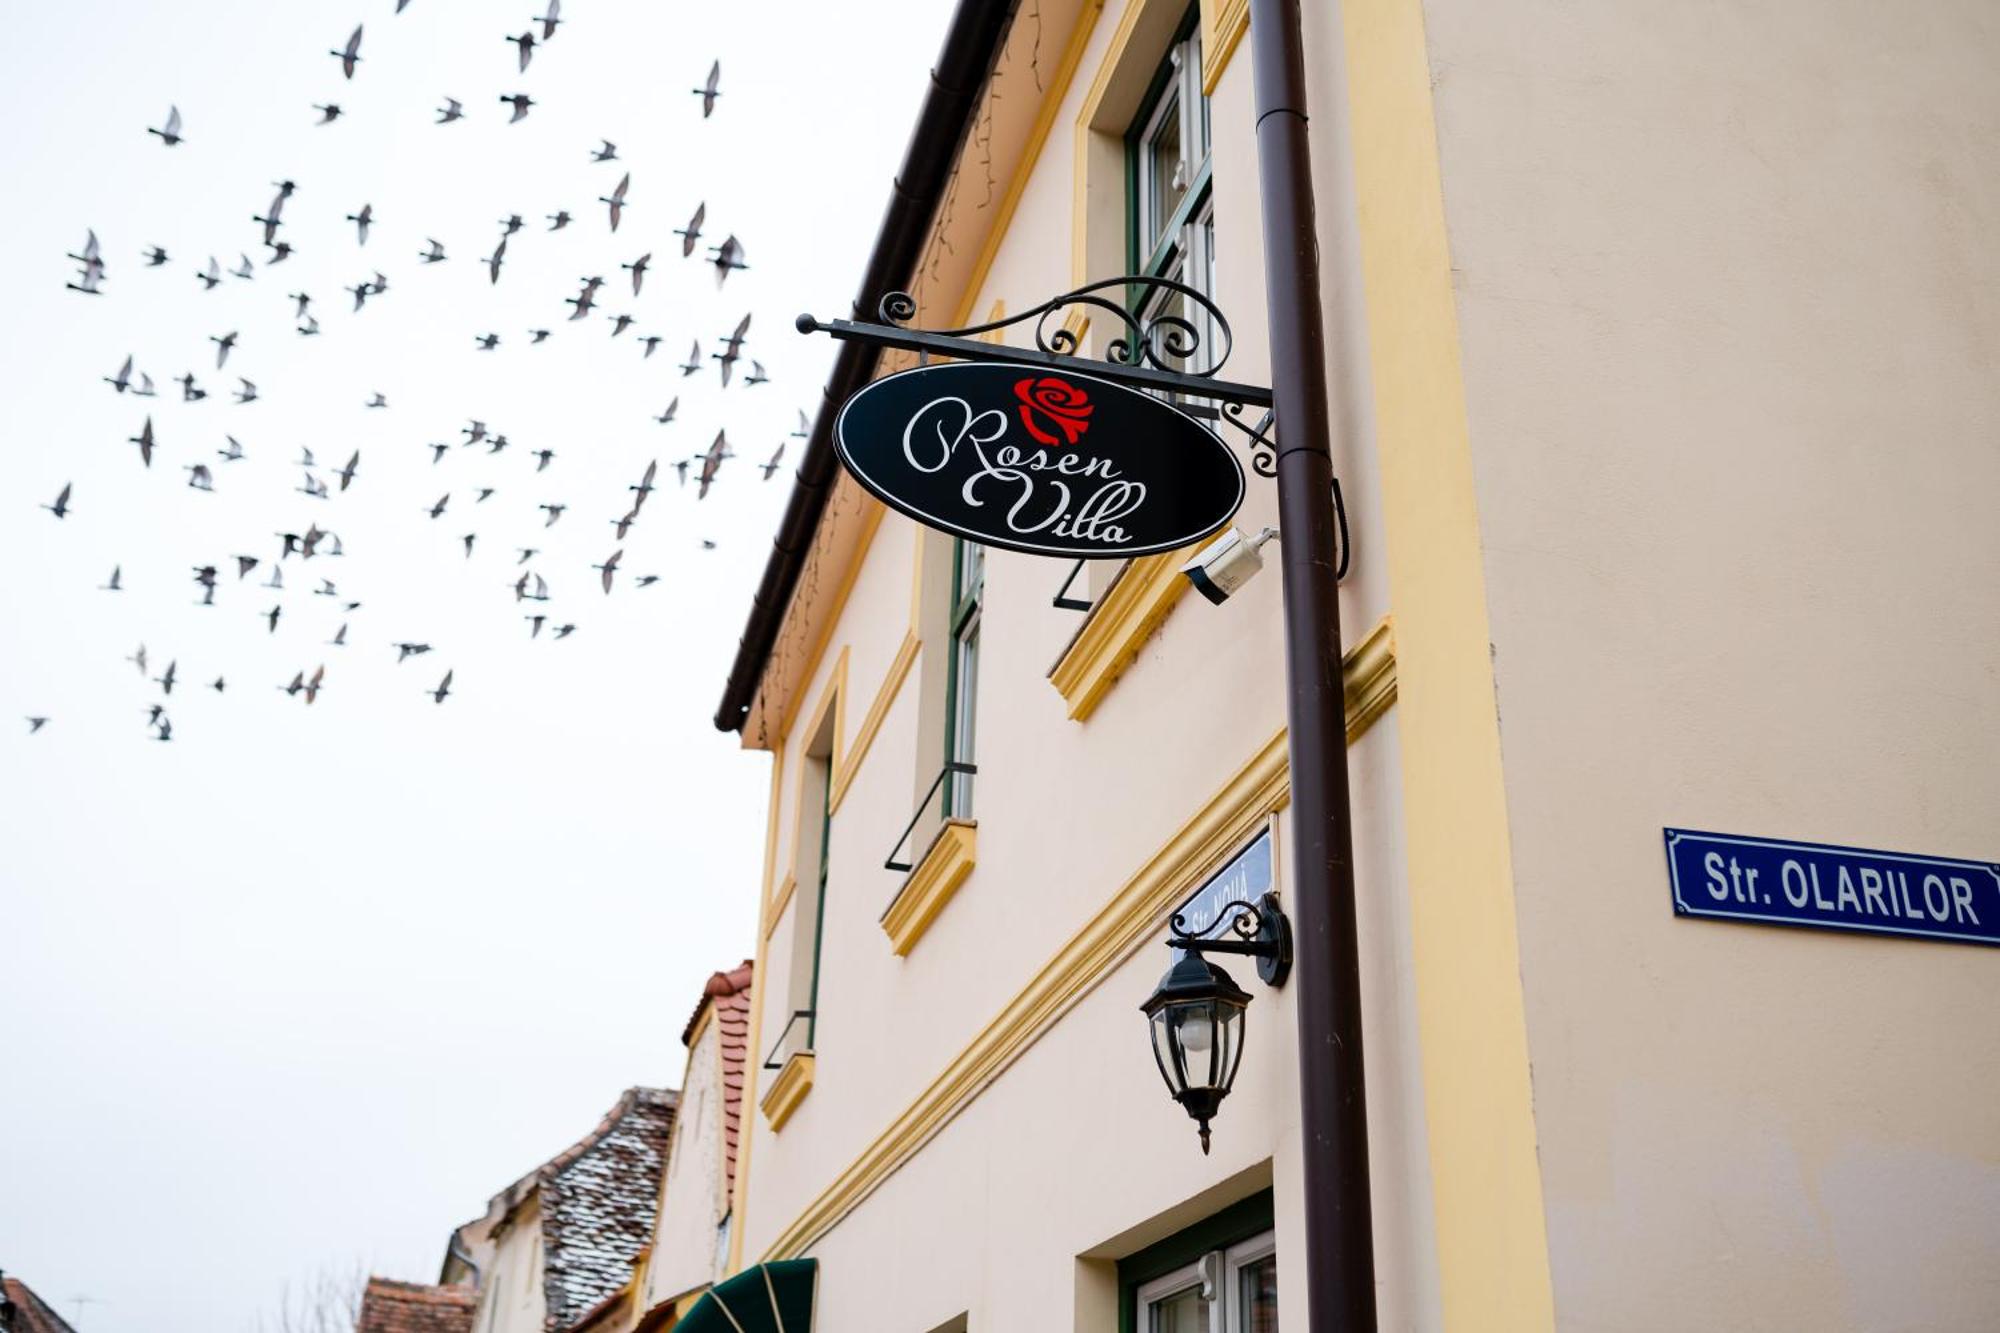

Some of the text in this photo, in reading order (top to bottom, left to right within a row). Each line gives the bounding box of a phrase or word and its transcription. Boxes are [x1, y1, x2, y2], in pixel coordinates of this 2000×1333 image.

[903, 396, 1122, 479] Rosen
[962, 467, 1147, 543] Villa
[1704, 851, 1981, 926] Str. OLARILOR
